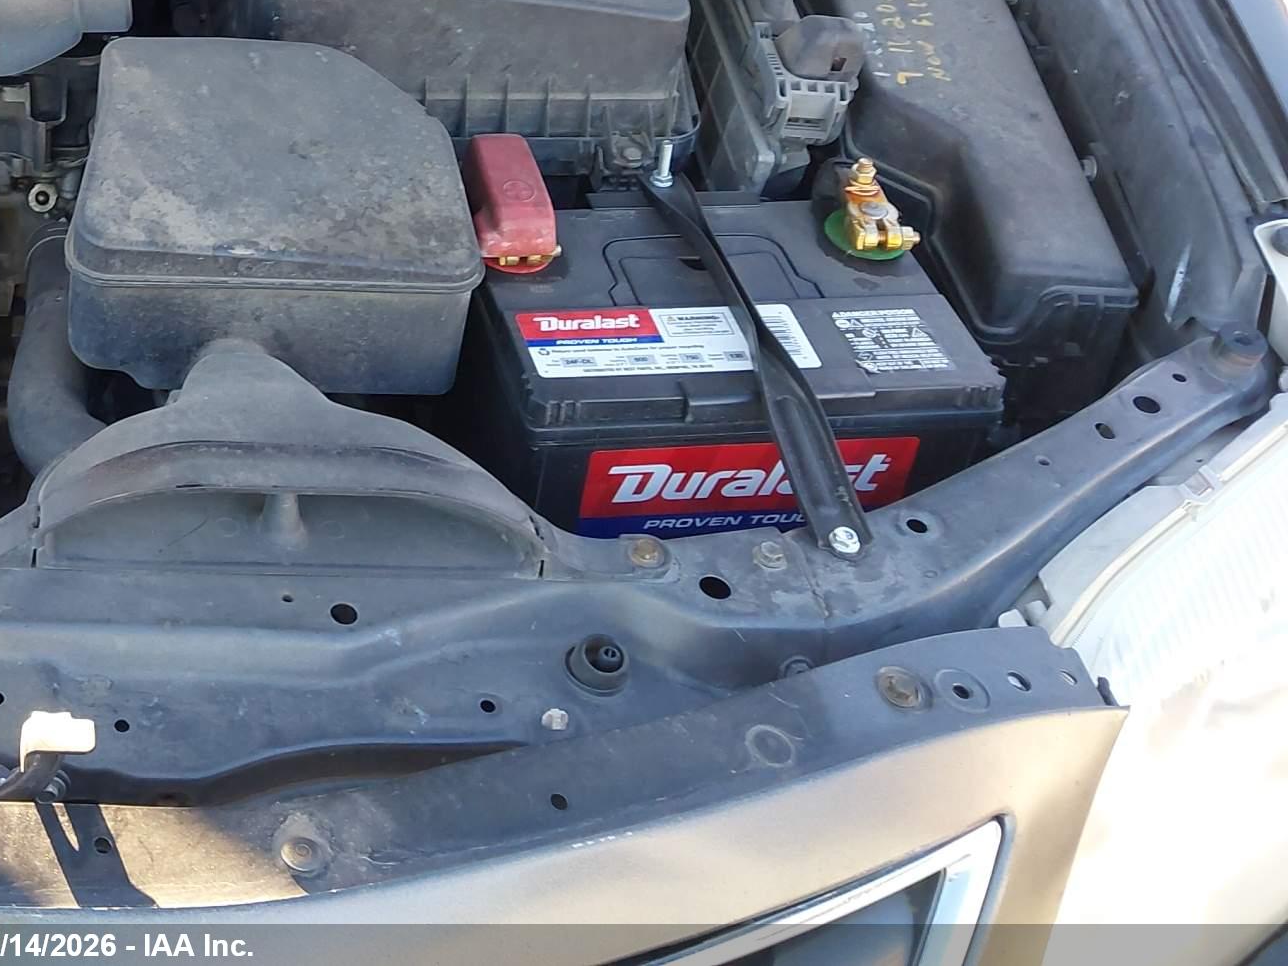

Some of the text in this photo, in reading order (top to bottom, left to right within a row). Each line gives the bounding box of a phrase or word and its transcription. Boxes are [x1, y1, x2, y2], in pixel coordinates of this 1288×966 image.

[533, 314, 640, 331] Duralast
[608, 453, 892, 503] Duralt
[644, 513, 805, 530] PROVEN TOU
